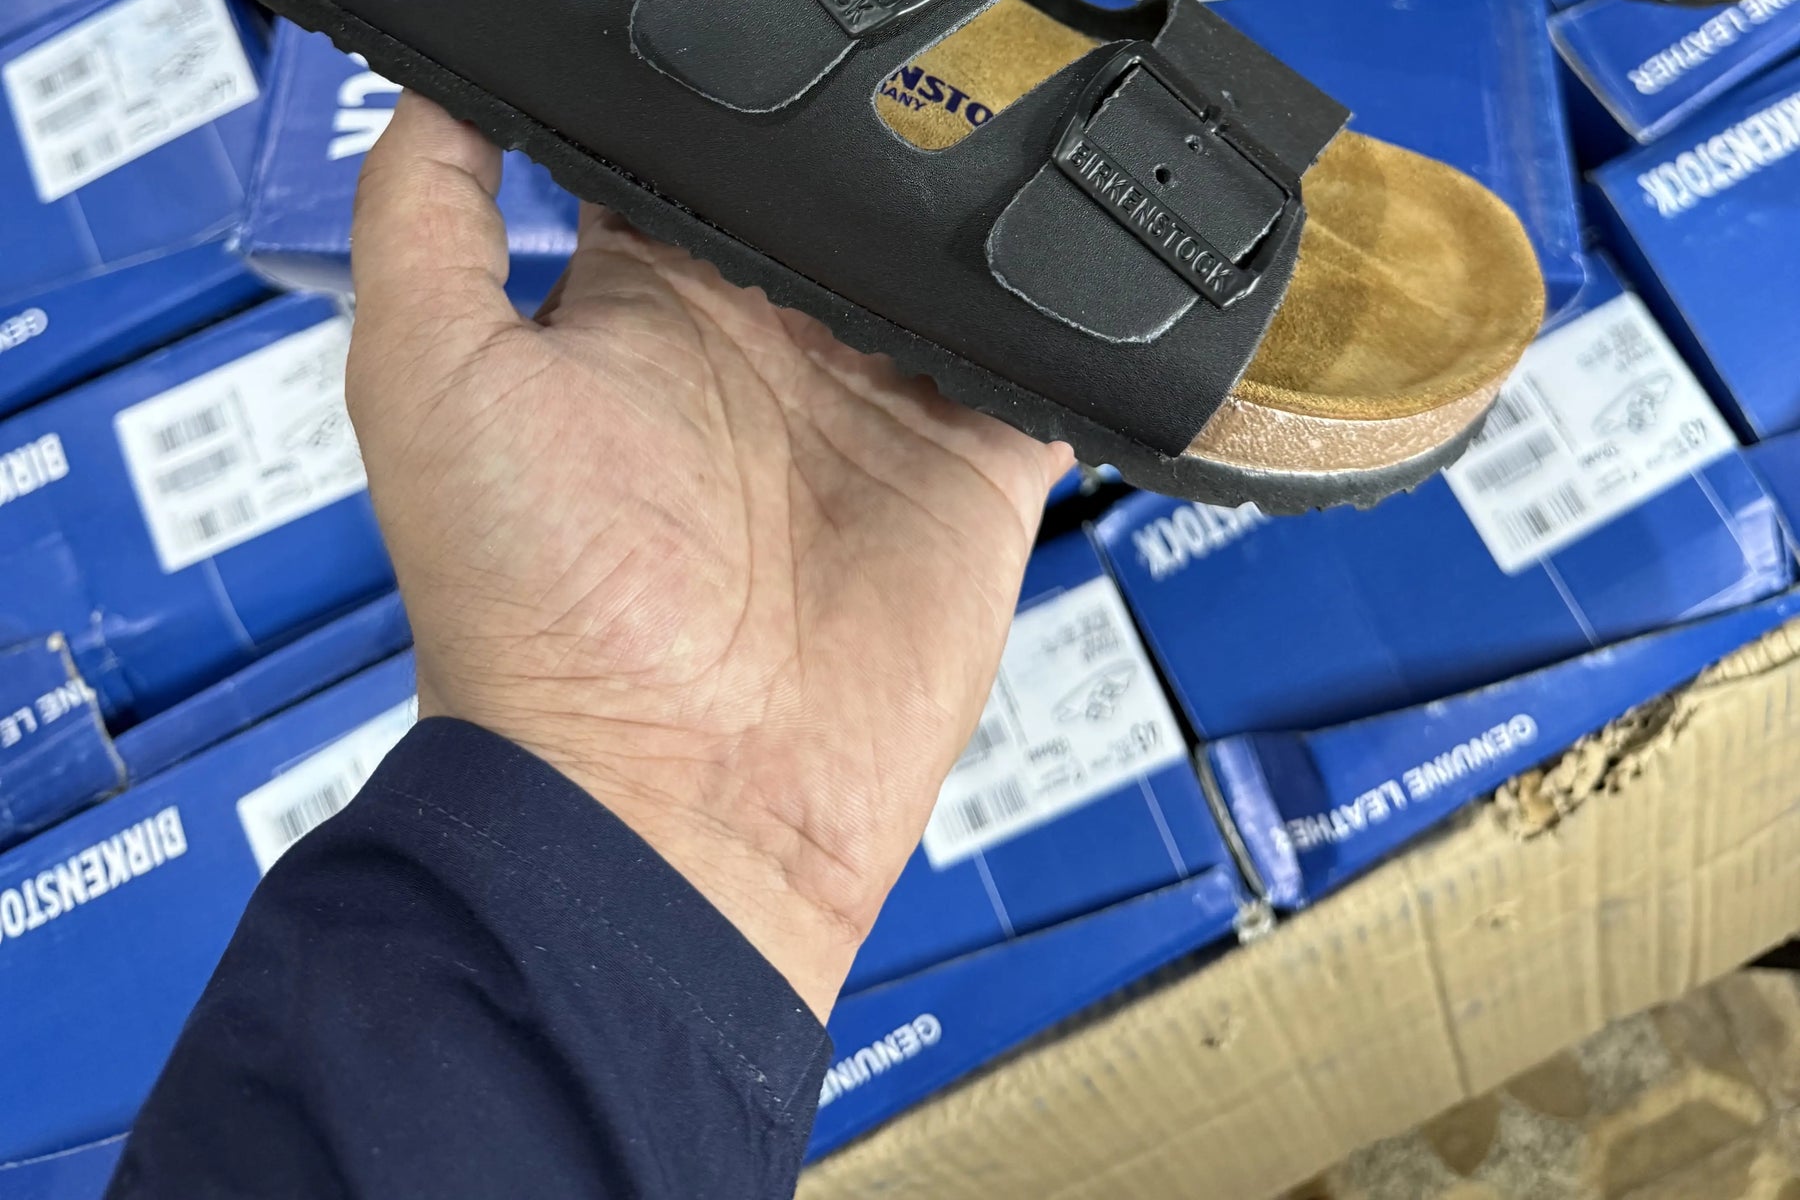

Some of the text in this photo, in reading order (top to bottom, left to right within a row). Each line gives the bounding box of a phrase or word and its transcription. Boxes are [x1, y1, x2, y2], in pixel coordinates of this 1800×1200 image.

[1627, 7, 1751, 95] LEATHER
[1066, 140, 1232, 292] BIRKENSTOCK
[1403, 714, 1538, 802] GENUINE
[0, 805, 188, 945] BIRKENSTO
